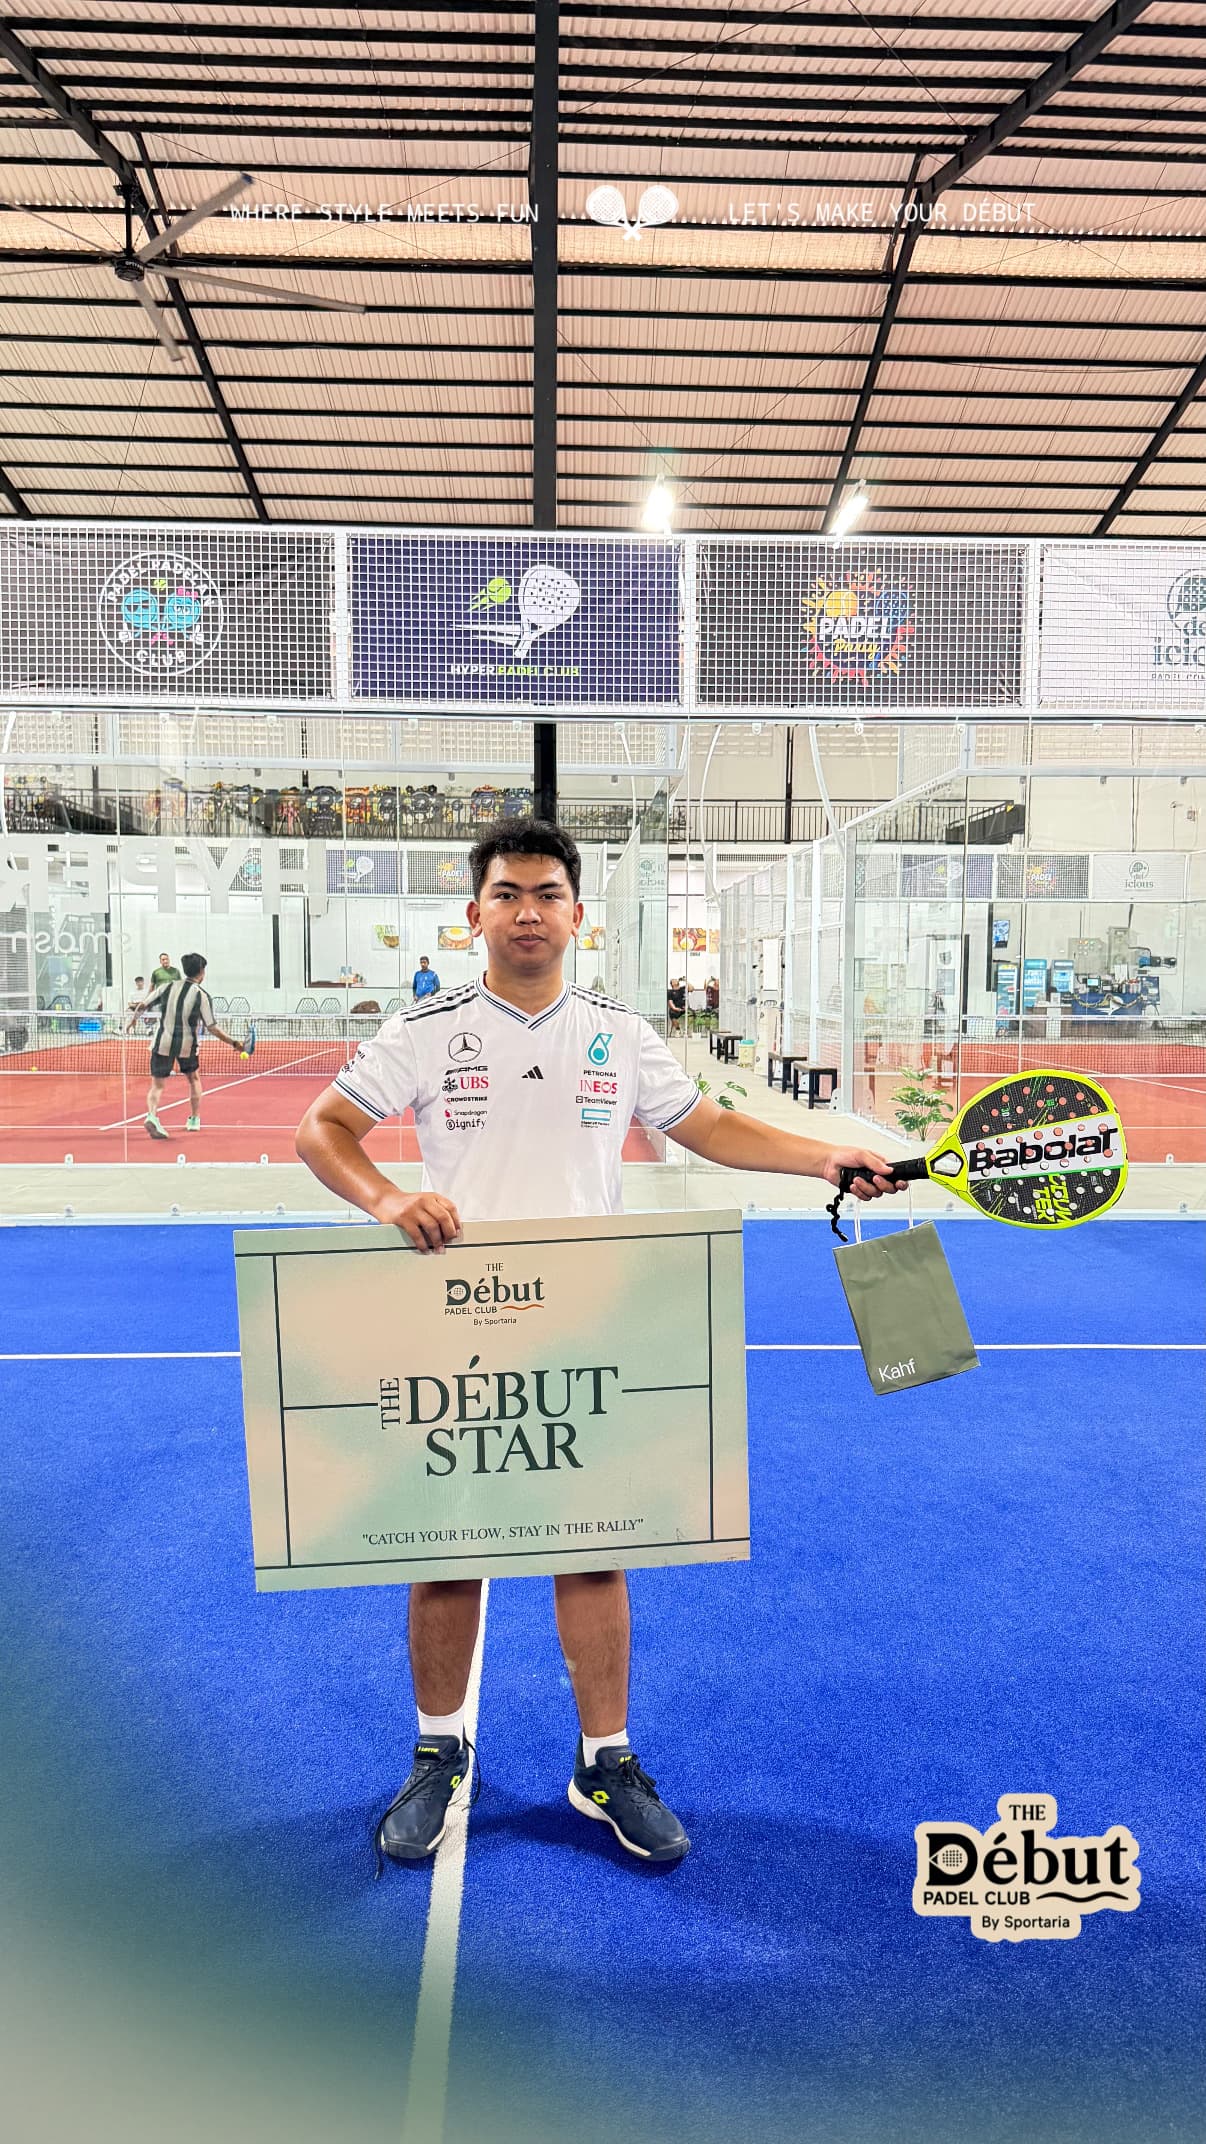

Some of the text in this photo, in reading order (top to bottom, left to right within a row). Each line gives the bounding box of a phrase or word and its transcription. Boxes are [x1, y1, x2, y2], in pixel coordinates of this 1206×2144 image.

[819, 616, 892, 641] PADEL
[450, 663, 495, 676] HYPER
[459, 1076, 490, 1090] UBS
[579, 1079, 618, 1095] INEOS
[968, 1127, 1119, 1173] Babolat
[485, 1262, 504, 1272] THE
[445, 1275, 545, 1306] Début
[444, 1305, 498, 1316] PADEL CLUB
[473, 1317, 517, 1326] By Sportaria
[878, 1358, 916, 1383] Kahf
[379, 1354, 619, 1430] THE DÉBUT
[426, 1422, 584, 1477] STAR
[362, 1518, 644, 1546] "CATCH YOUR FLOW, STAY IN THE RALLY"
